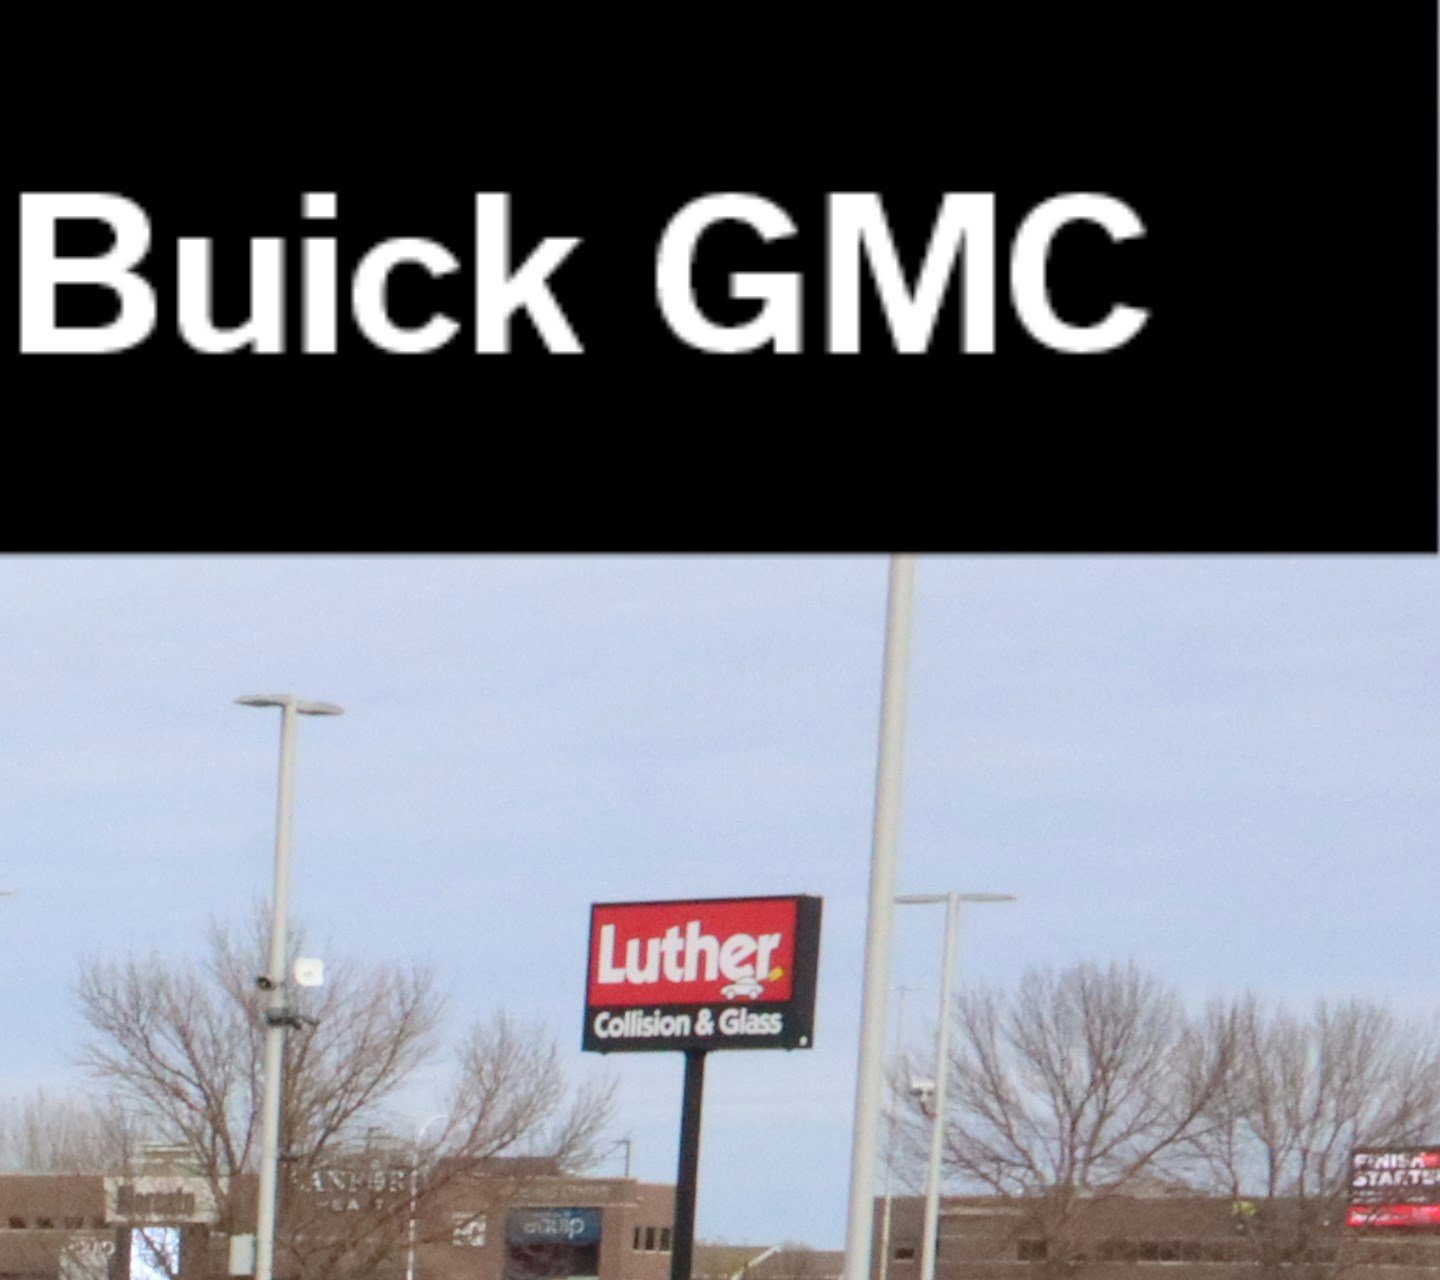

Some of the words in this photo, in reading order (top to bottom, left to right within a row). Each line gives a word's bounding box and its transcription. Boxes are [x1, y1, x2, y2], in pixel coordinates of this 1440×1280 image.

[598, 920, 782, 984] Luther
[594, 1009, 691, 1037] Collision
[694, 1007, 715, 1036] &
[719, 1006, 784, 1035] Glass
